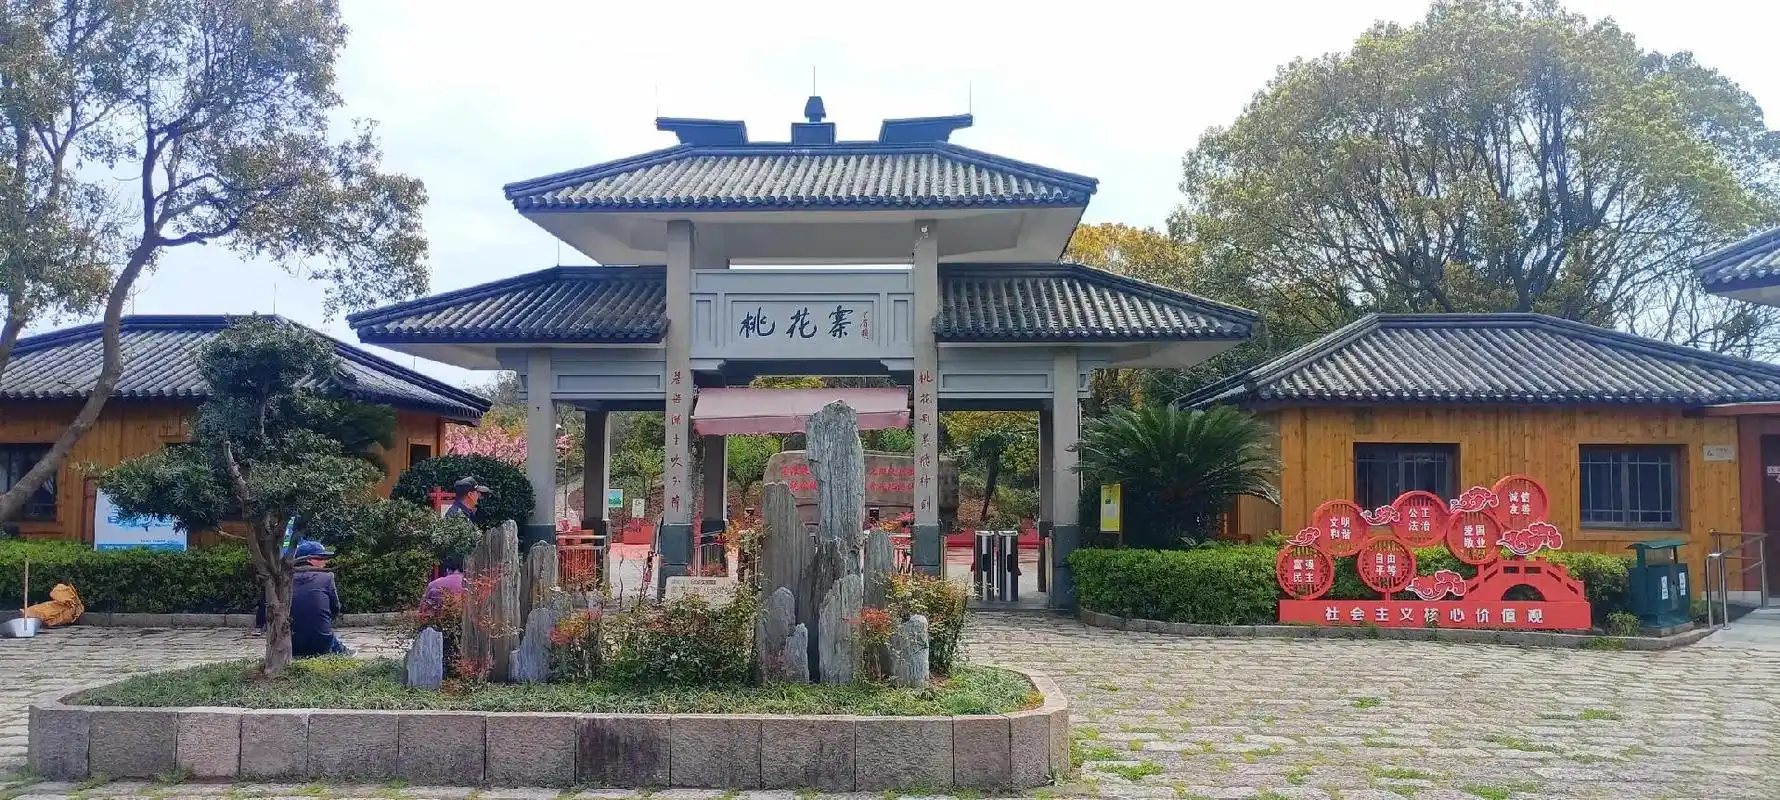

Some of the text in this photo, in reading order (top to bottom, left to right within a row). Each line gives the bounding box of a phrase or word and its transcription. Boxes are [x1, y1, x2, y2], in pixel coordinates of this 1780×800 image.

[739, 304, 854, 339] 桃花寨
[1508, 491, 1530, 503] 诚信
[1408, 508, 1430, 519] 公正
[1509, 503, 1530, 515] 友善
[1329, 516, 1351, 529] 文明
[1408, 519, 1430, 532] 法治
[1329, 528, 1351, 541] 和谐
[1464, 525, 1485, 537] 爱国
[1464, 537, 1486, 549] 敬业
[1293, 559, 1314, 571] 富强
[1375, 553, 1396, 565] 自由
[1375, 565, 1397, 577] 平等
[1293, 571, 1314, 584] 民主
[1325, 607, 1543, 623] 社会主义核心价值观
